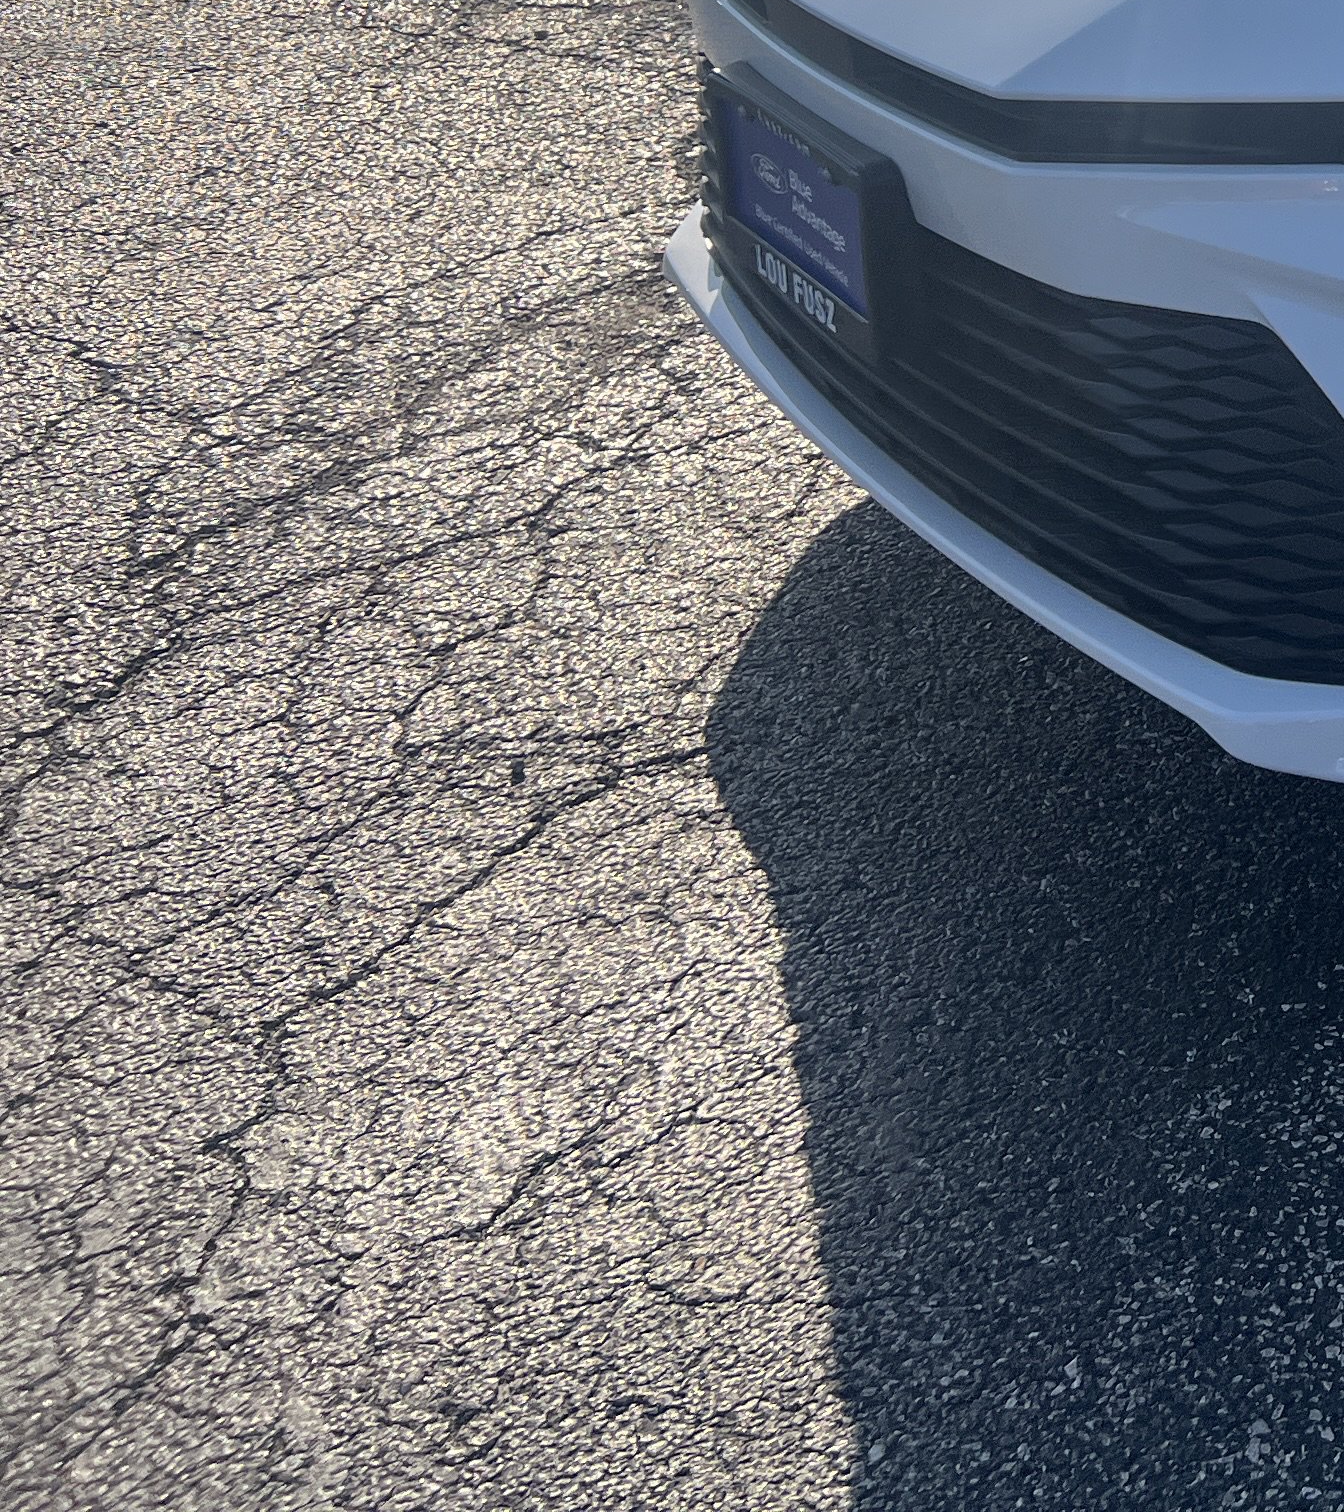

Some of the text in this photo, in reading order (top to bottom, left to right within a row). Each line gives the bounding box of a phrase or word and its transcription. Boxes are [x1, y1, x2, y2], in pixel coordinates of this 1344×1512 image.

[788, 168, 812, 202] Blue
[792, 195, 846, 252] Advantage
[754, 244, 837, 334] LOU FUSZ
